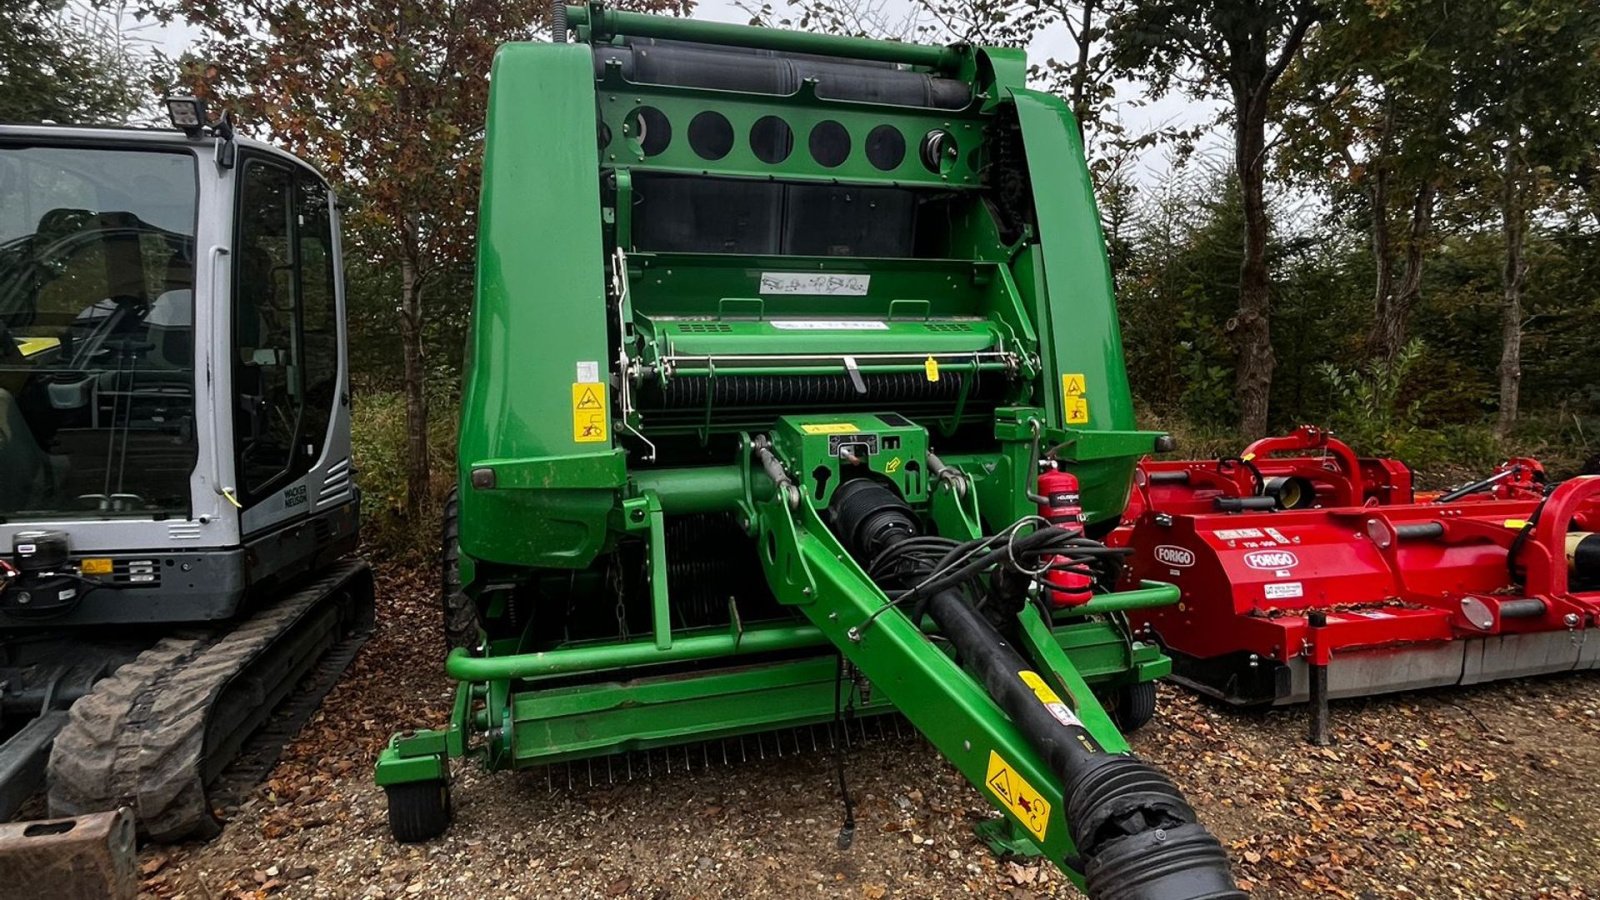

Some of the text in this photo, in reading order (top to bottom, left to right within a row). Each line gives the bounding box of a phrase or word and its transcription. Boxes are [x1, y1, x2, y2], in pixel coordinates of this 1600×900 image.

[284, 485, 306, 498] WACKER
[284, 495, 307, 508] NEUSON
[1158, 548, 1191, 564] FORIGO
[1249, 553, 1293, 566] FORIGO
